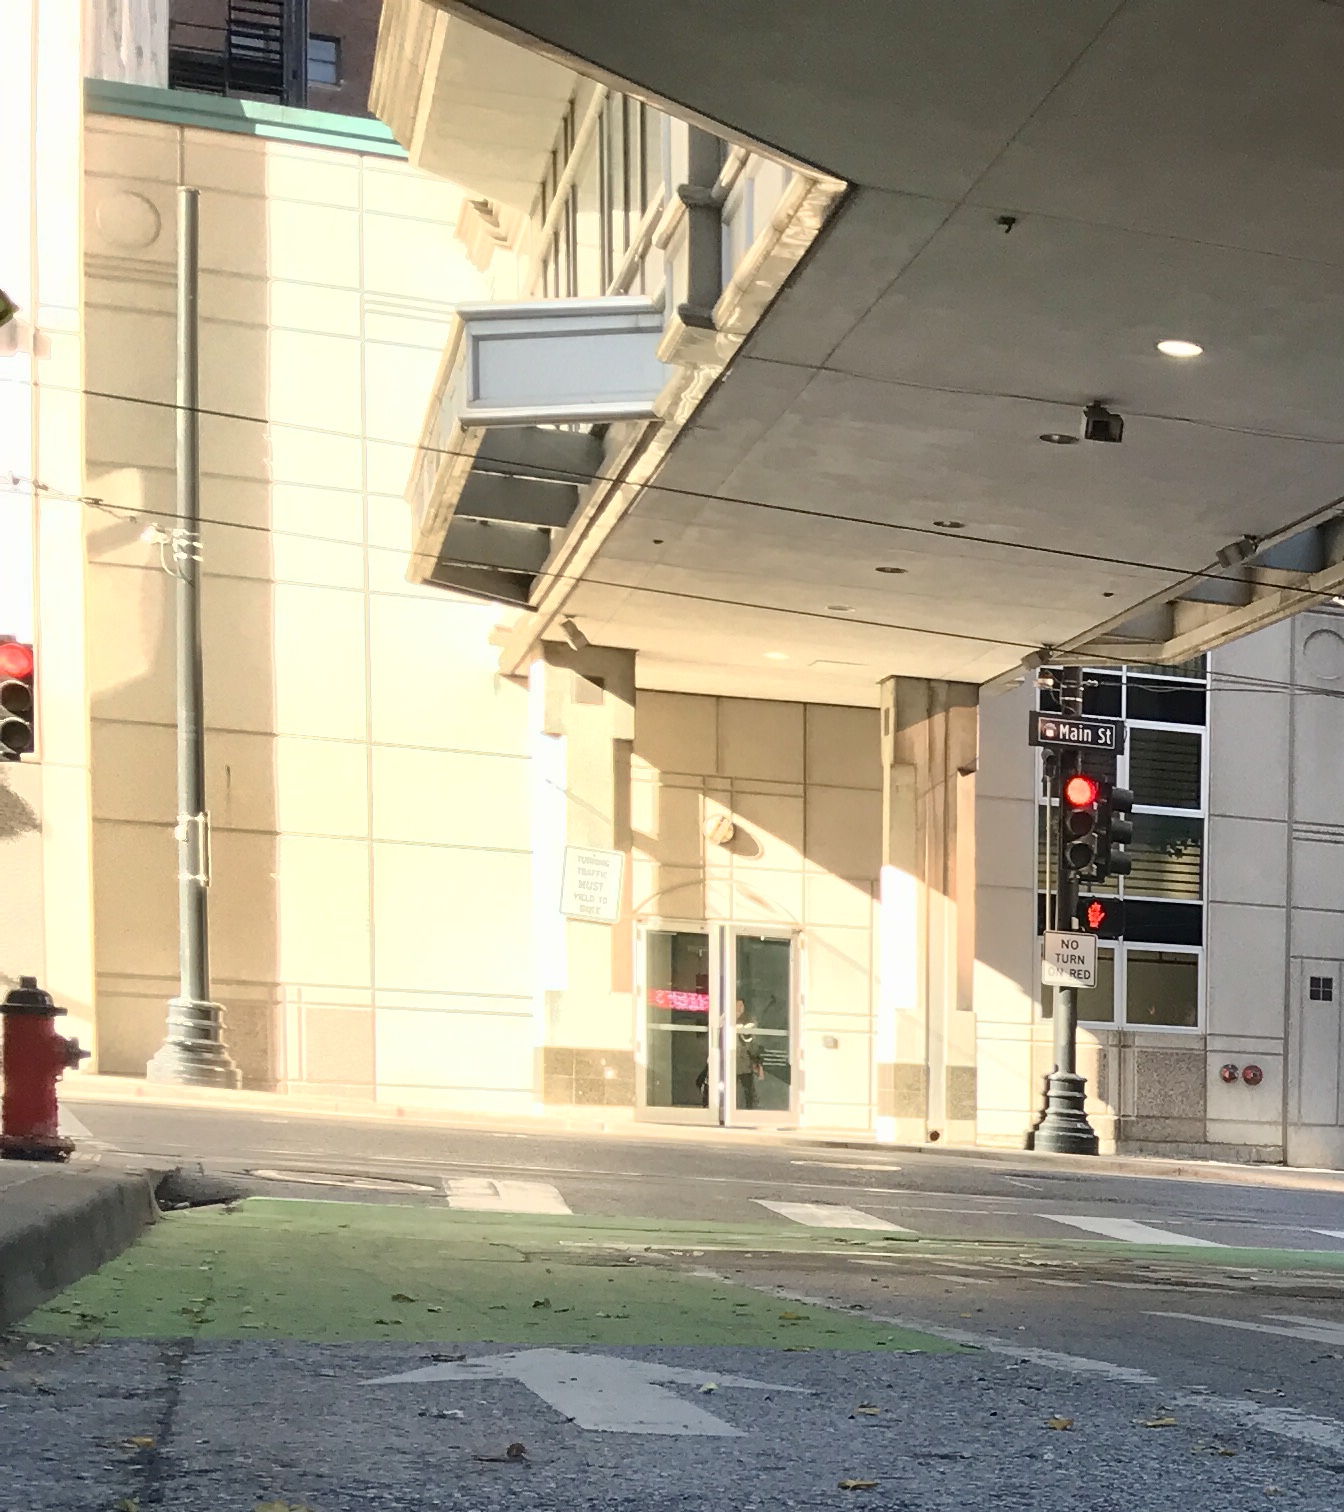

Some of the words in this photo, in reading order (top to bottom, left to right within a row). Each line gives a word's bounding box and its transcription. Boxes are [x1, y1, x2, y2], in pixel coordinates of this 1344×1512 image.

[1059, 723, 1092, 742] Main
[1097, 727, 1112, 745] St
[578, 879, 604, 892] MUST
[598, 896, 608, 905] TO
[1061, 939, 1079, 950] NO
[1055, 953, 1085, 965] TURN
[1048, 966, 1064, 978] ON
[1069, 968, 1091, 980] RED
